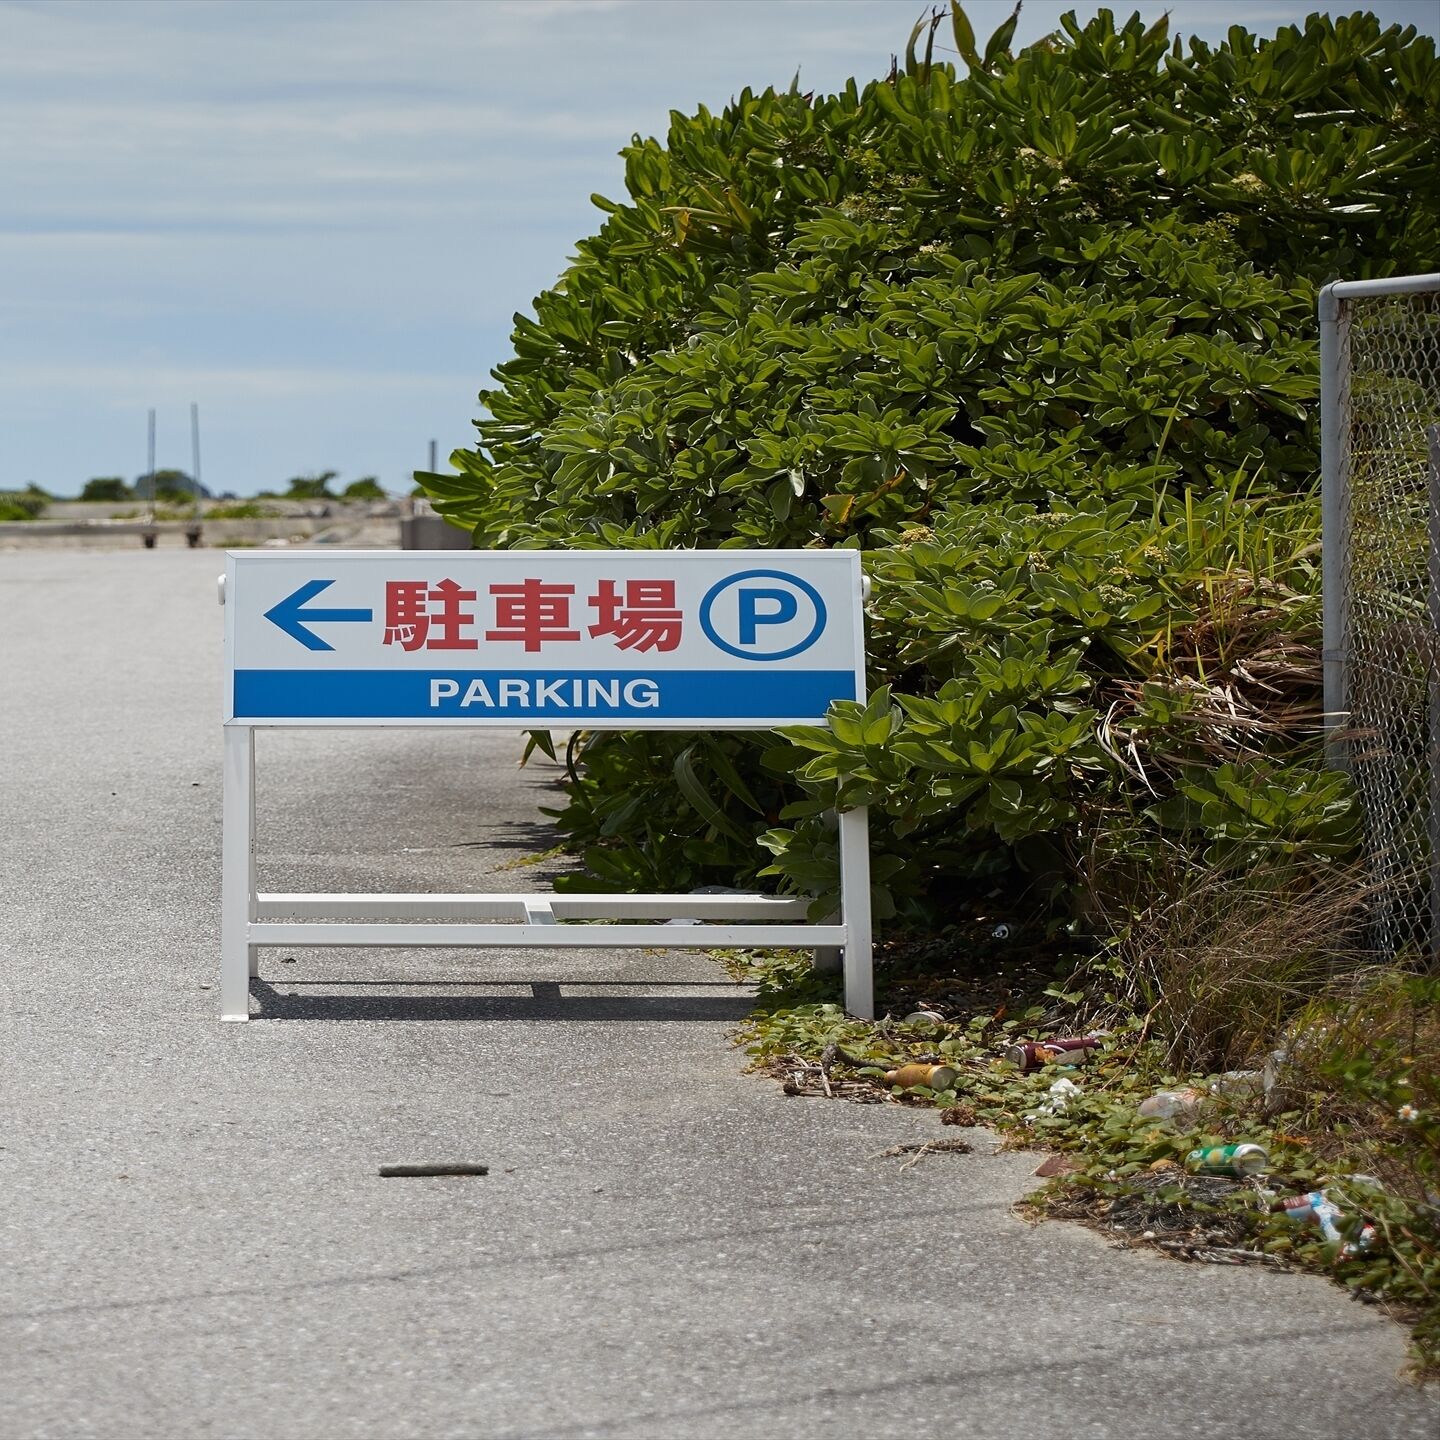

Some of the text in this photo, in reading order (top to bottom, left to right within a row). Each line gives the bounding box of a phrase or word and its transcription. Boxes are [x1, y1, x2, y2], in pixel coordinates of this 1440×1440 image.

[382, 578, 798, 652] 駐車場 P
[429, 678, 660, 708] PARKING
